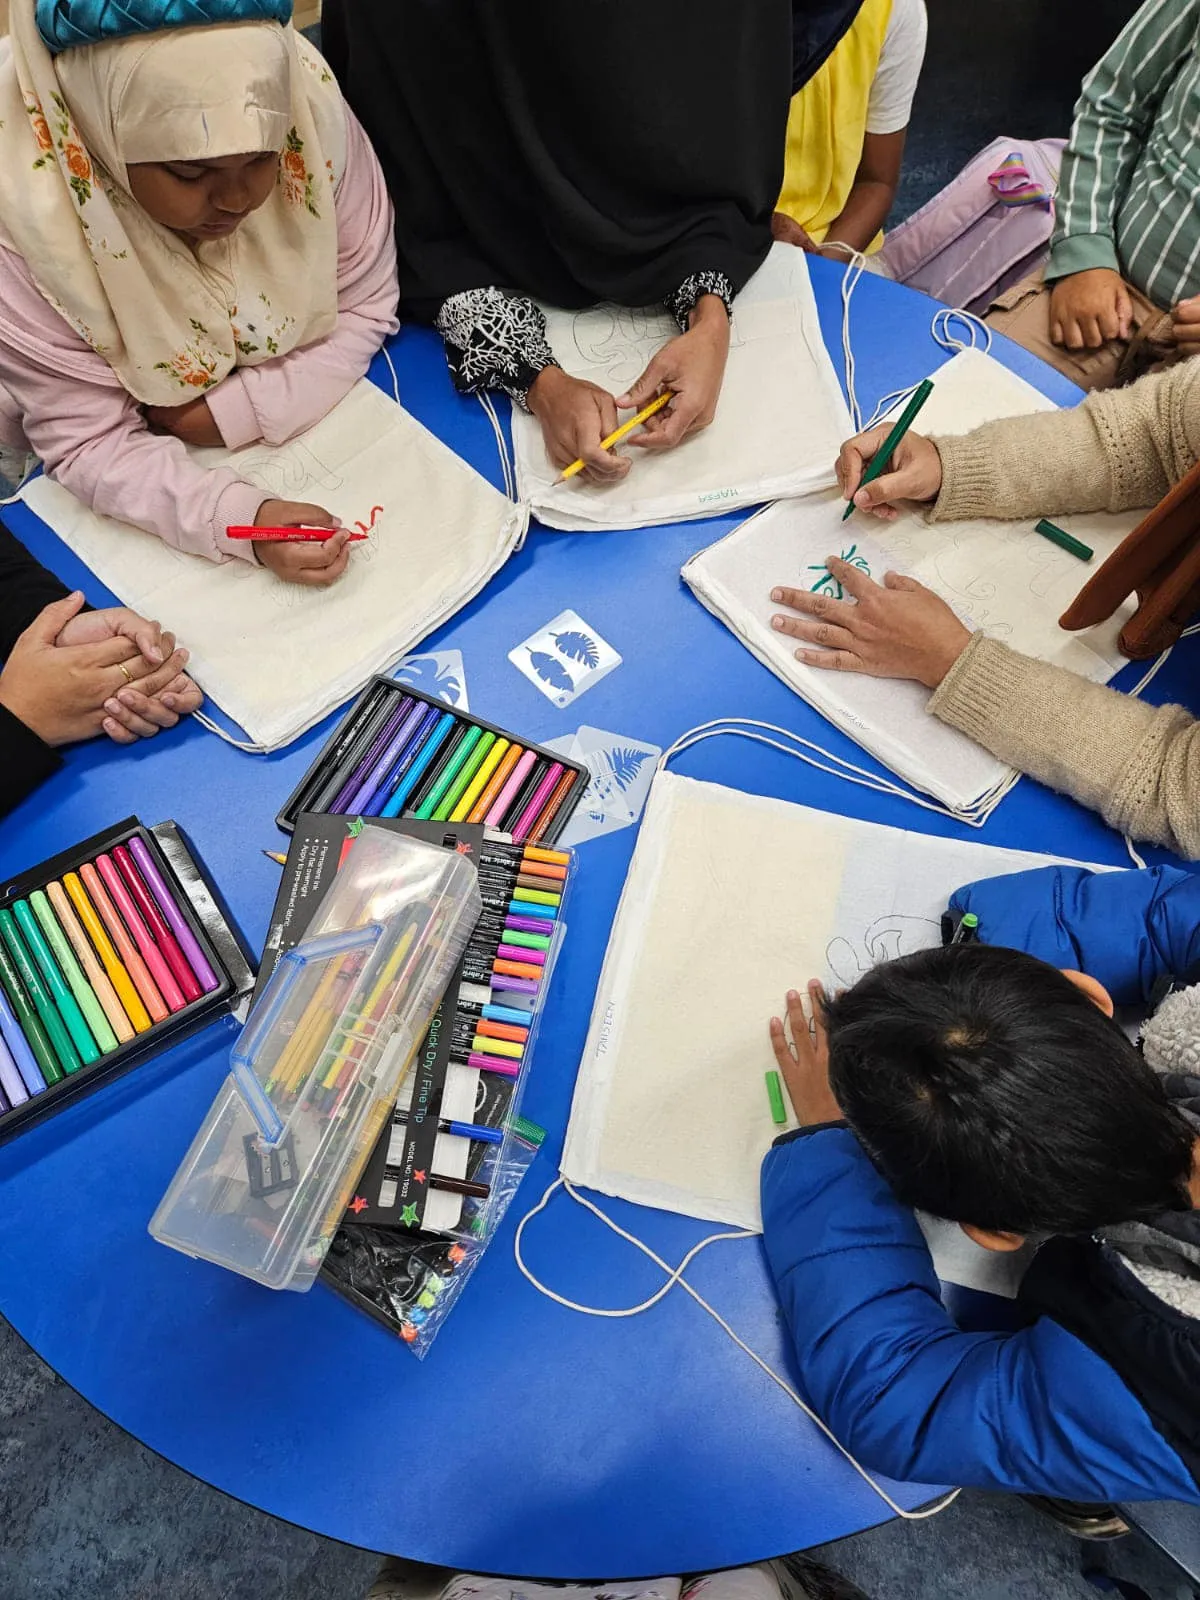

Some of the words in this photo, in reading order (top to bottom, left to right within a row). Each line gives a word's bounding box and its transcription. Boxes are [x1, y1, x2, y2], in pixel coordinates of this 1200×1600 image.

[298, 845, 309, 862] Apply
[309, 845, 319, 857] Dry
[315, 846, 328, 880] Permanent
[300, 868, 312, 897] overnight
[312, 880, 320, 891] ink
[428, 1019, 442, 1048] Quick
[422, 1051, 437, 1070] Dry
[418, 1079, 433, 1103] Fine
[414, 1106, 428, 1123] Tip
[406, 1141, 416, 1163] MODEL
